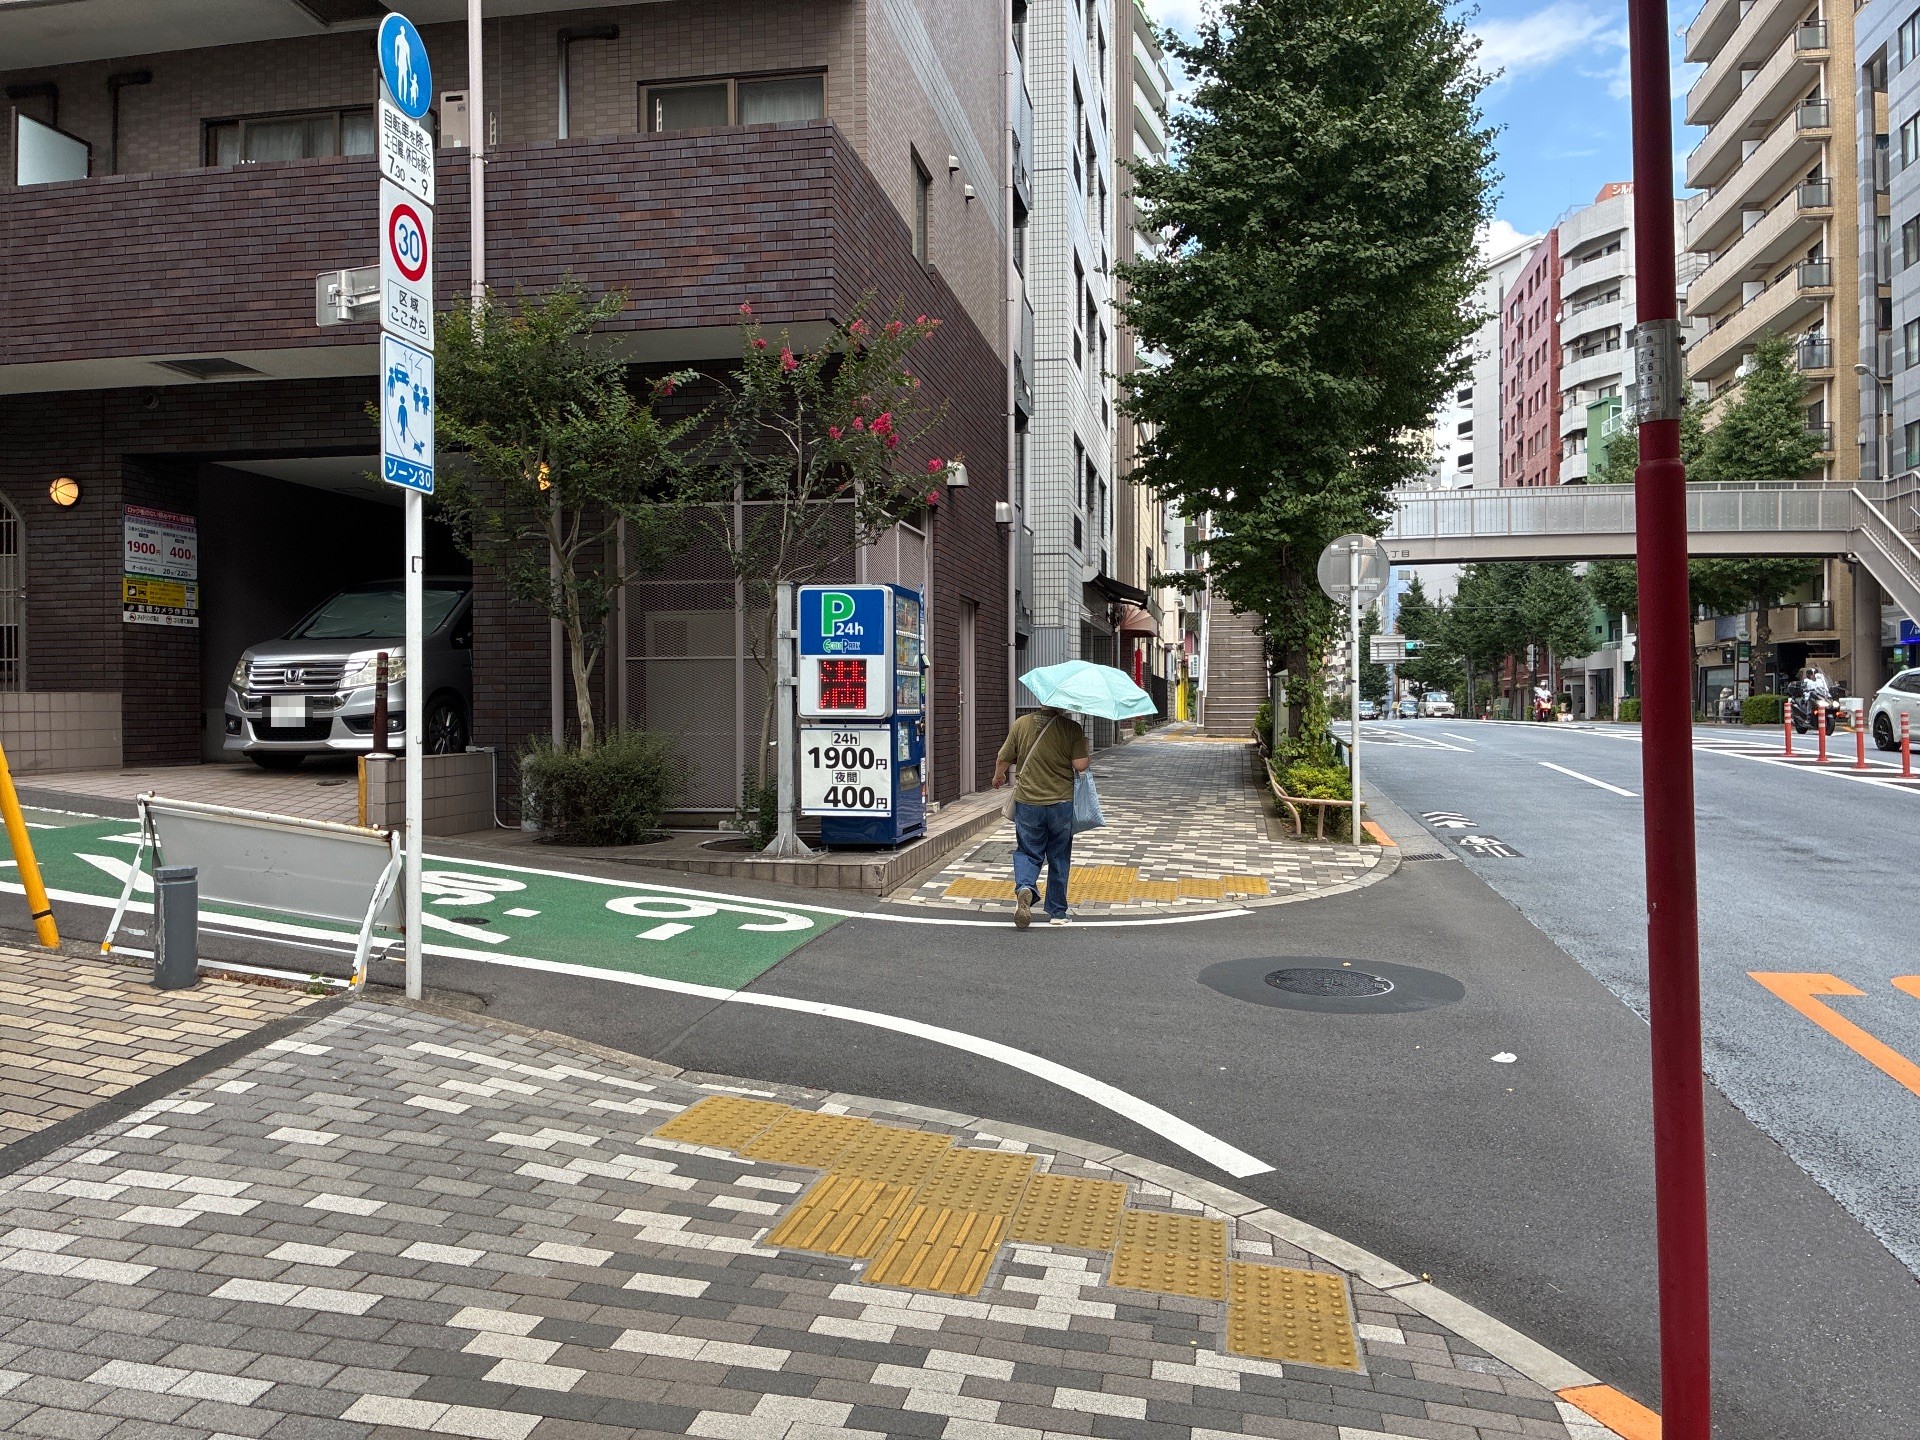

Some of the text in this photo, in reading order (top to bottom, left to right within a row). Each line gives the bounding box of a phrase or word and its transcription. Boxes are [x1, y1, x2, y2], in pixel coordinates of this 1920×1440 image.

[384, 109, 430, 156] 自転車を除く
[421, 179, 428, 196] 9
[399, 224, 419, 263] 30
[399, 290, 418, 313] 区域
[391, 305, 427, 334] ここから
[1386, 549, 1410, 558] 丁目
[822, 592, 855, 637] P
[835, 621, 864, 636] 24h
[820, 661, 867, 709] 満
[833, 732, 858, 745] 24h
[808, 747, 887, 770] 1900円
[835, 771, 858, 784] 夜間
[823, 786, 888, 810] 400円
